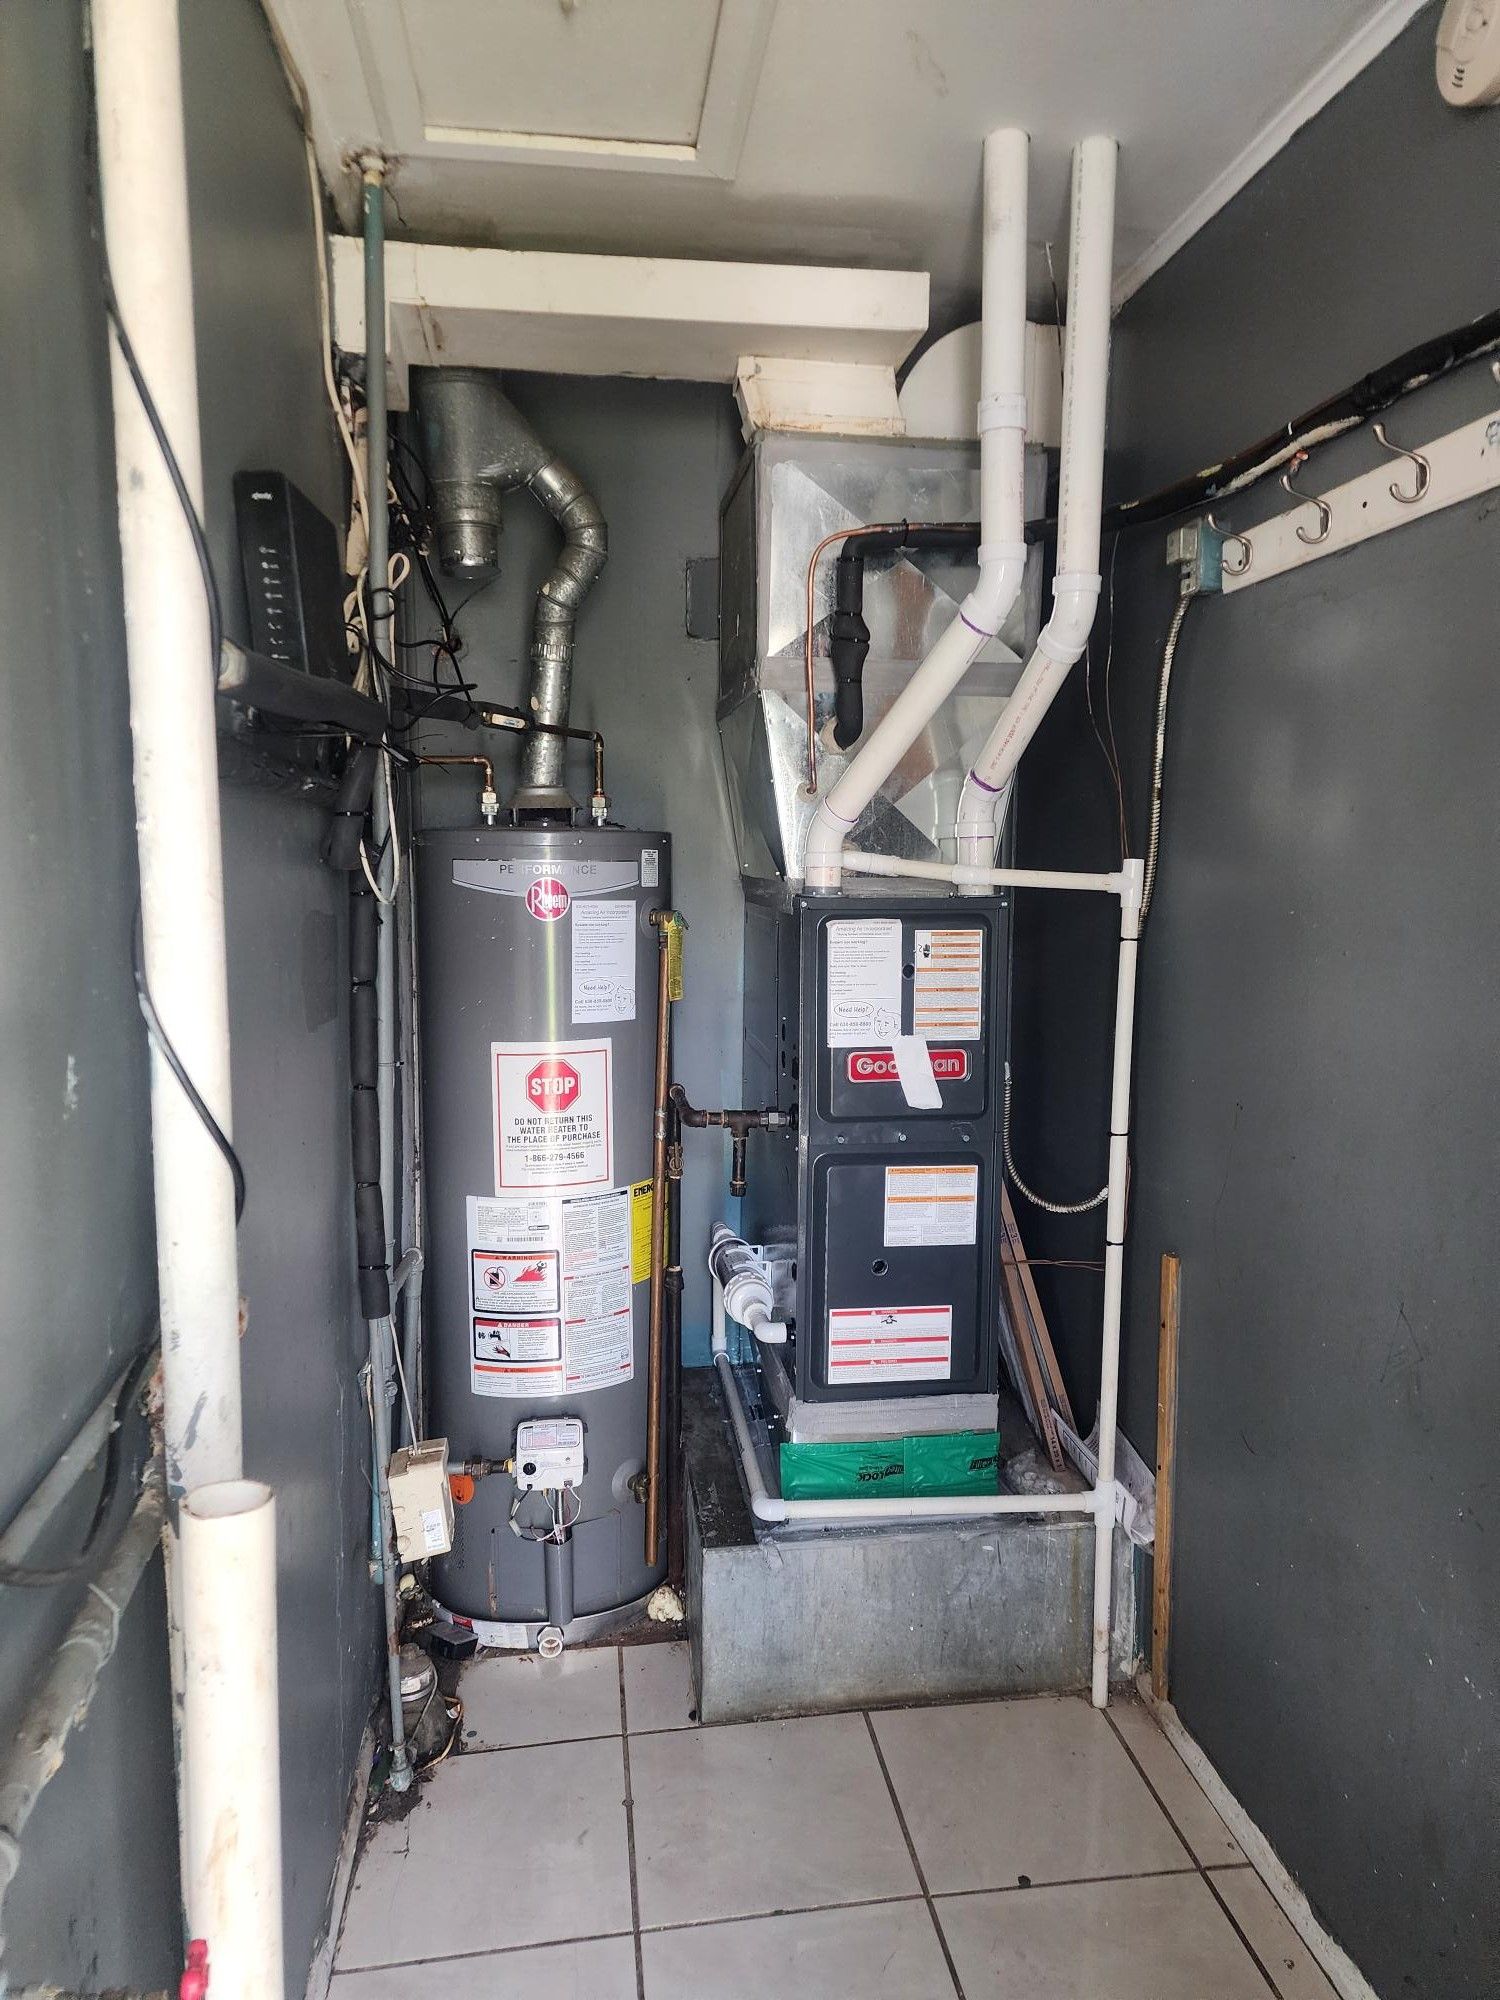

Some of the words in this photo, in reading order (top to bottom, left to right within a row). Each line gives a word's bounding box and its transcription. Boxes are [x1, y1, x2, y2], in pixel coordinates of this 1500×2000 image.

[531, 878, 568, 915] Rheem
[856, 1057, 960, 1075] Gooan
[531, 1076, 576, 1096] STOP
[514, 1117, 525, 1126] DO
[527, 1117, 542, 1126] NOT
[544, 1115, 574, 1125] RETURN
[576, 1114, 593, 1123] THIS
[520, 1126, 546, 1135] WATER
[548, 1124, 577, 1134] HEATER
[579, 1123, 588, 1131] TO
[507, 1135, 521, 1143] THE
[523, 1135, 548, 1143] PLACE
[550, 1134, 560, 1142] OF
[562, 1131, 601, 1142] PURCHASE
[524, 1151, 585, 1162] 1-866-279-4566
